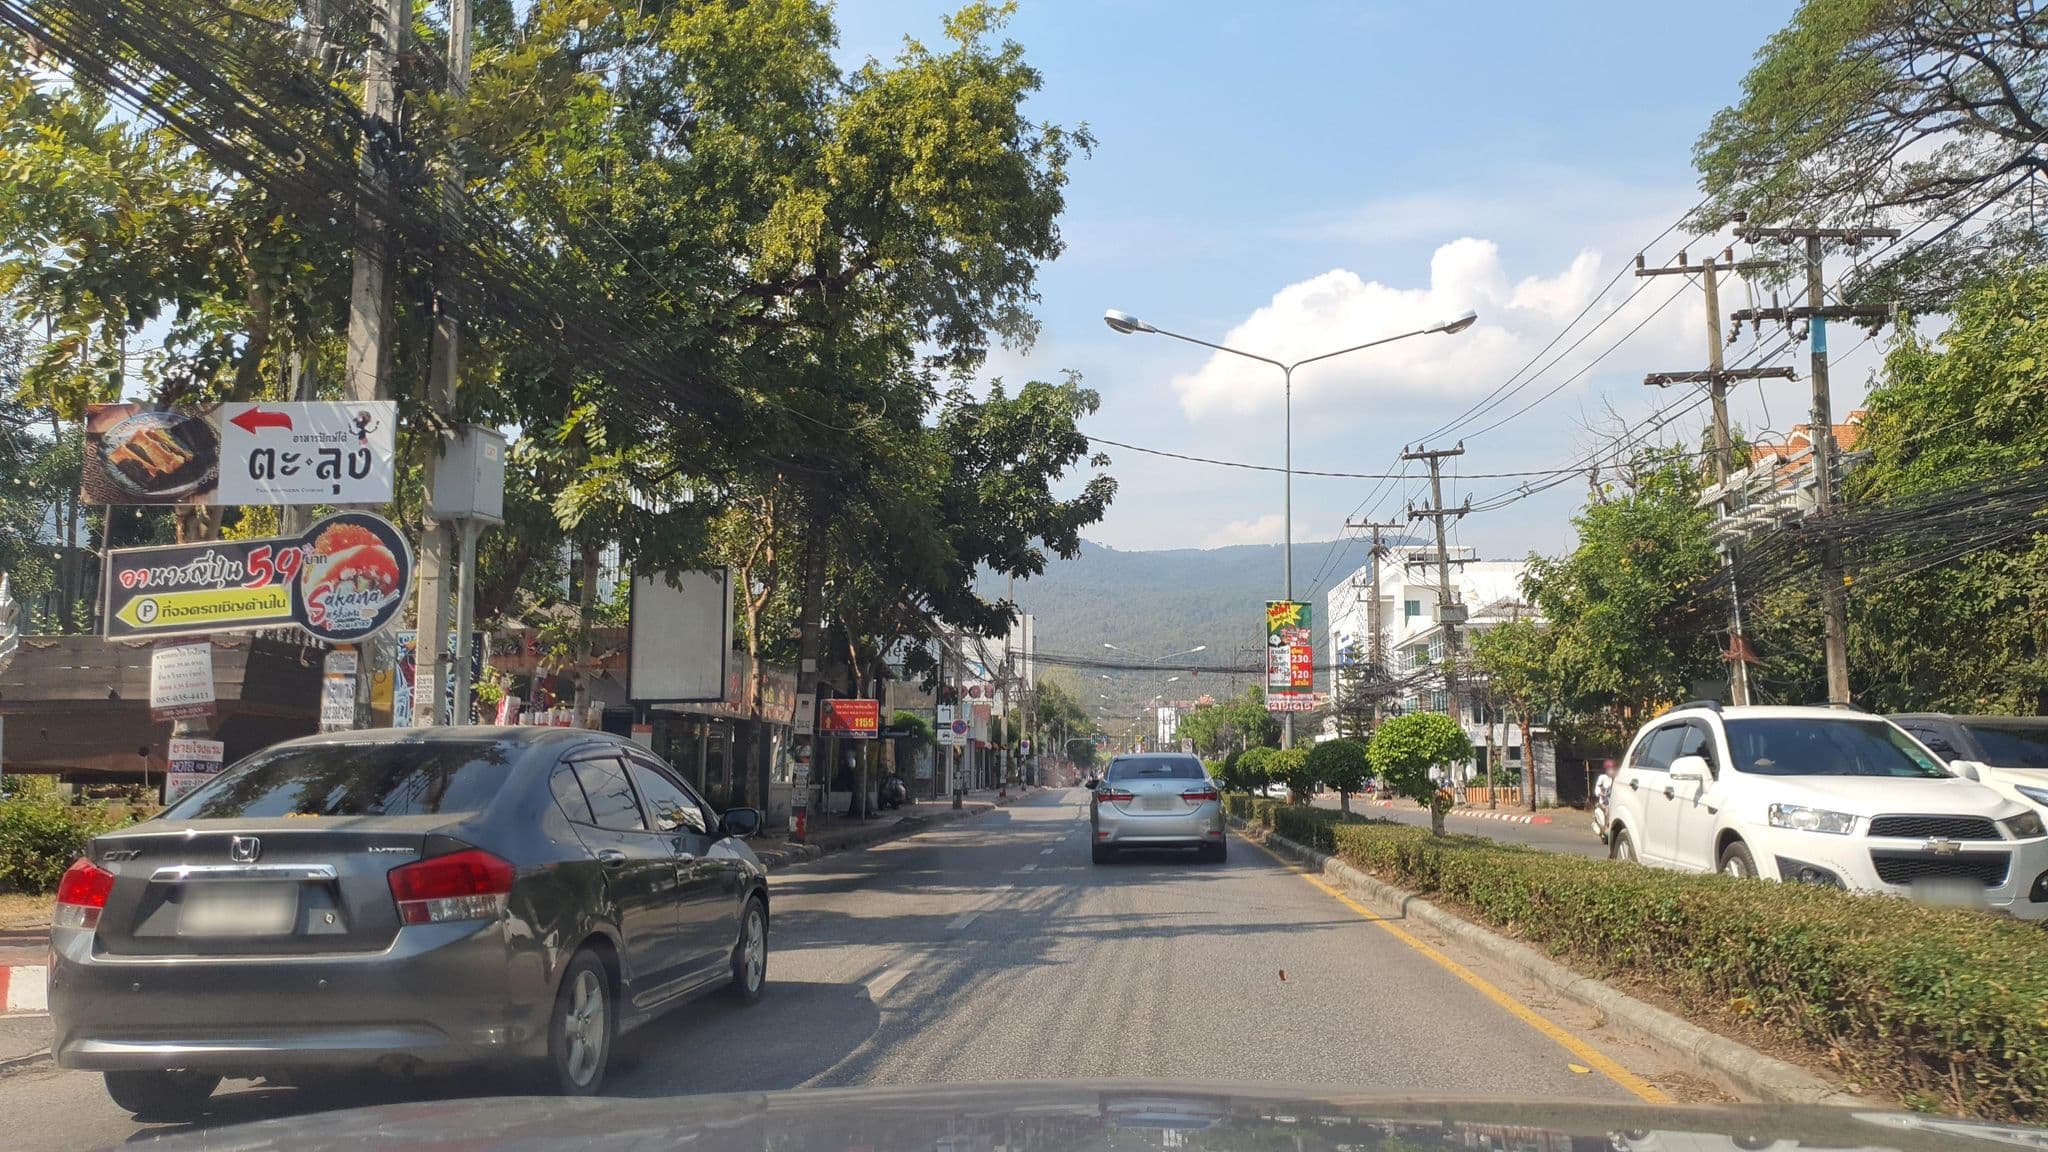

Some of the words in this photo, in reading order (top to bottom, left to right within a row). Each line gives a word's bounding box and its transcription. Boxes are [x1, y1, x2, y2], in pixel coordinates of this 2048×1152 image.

[119, 550, 244, 589] อาหารญี่ปุ่น
[241, 545, 304, 589] 59
[162, 594, 286, 618] ที่จอดรถเชิญด้านใน
[854, 717, 874, 728] 1155
